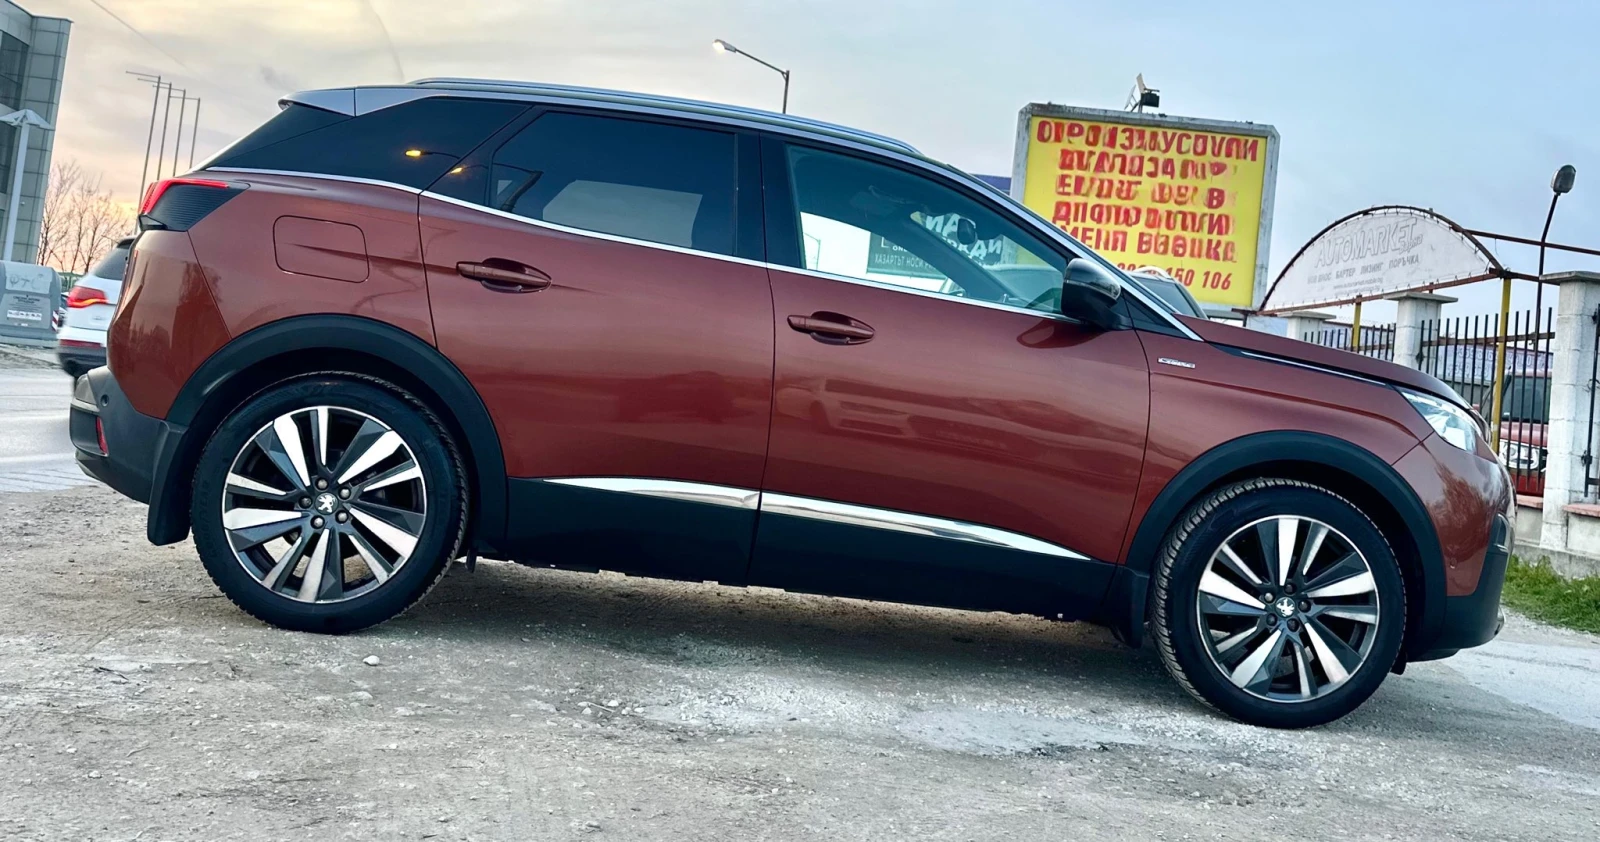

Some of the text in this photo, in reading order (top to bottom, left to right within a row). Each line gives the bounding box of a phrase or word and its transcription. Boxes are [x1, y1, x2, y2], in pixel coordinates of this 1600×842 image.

[1314, 217, 1418, 268] AUTOMARKET
[1388, 254, 1419, 269] ПОРЪЧКА
[1202, 270, 1232, 290] 106
